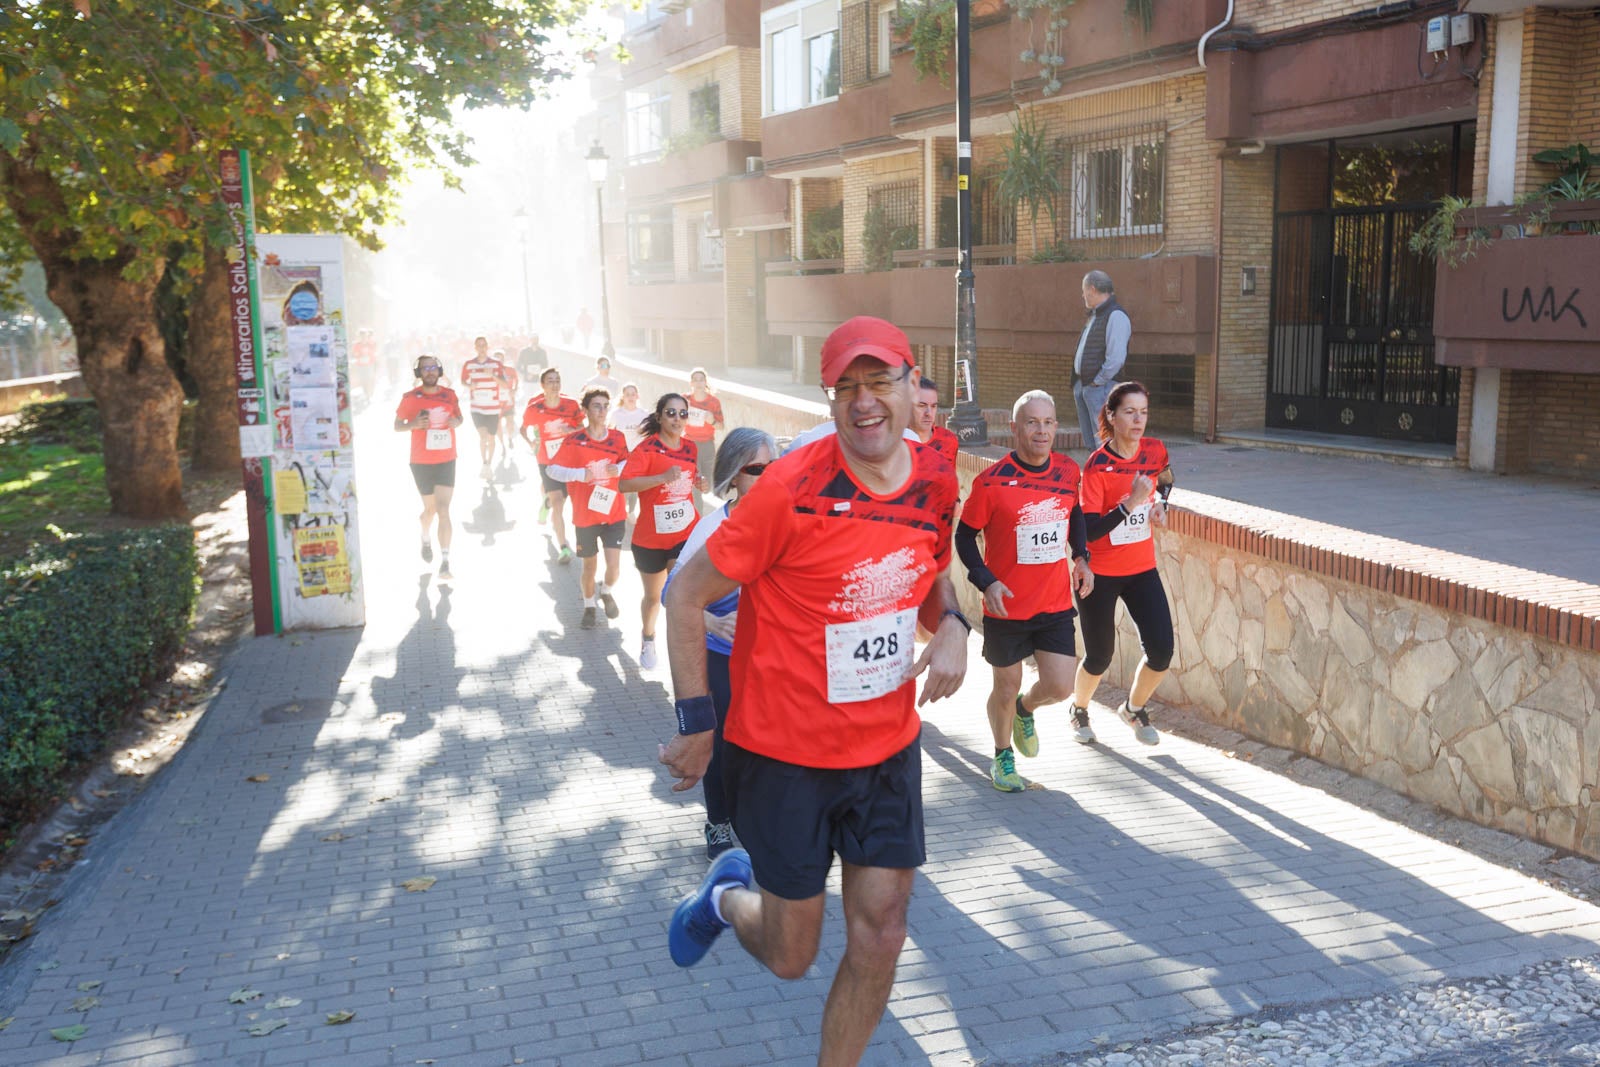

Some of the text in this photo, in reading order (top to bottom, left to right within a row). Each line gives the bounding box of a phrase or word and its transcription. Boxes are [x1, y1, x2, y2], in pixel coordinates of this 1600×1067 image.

[228, 202, 248, 294] Saluas
[664, 508, 684, 520] 369
[1031, 530, 1058, 546] 164
[853, 632, 899, 662] 428
